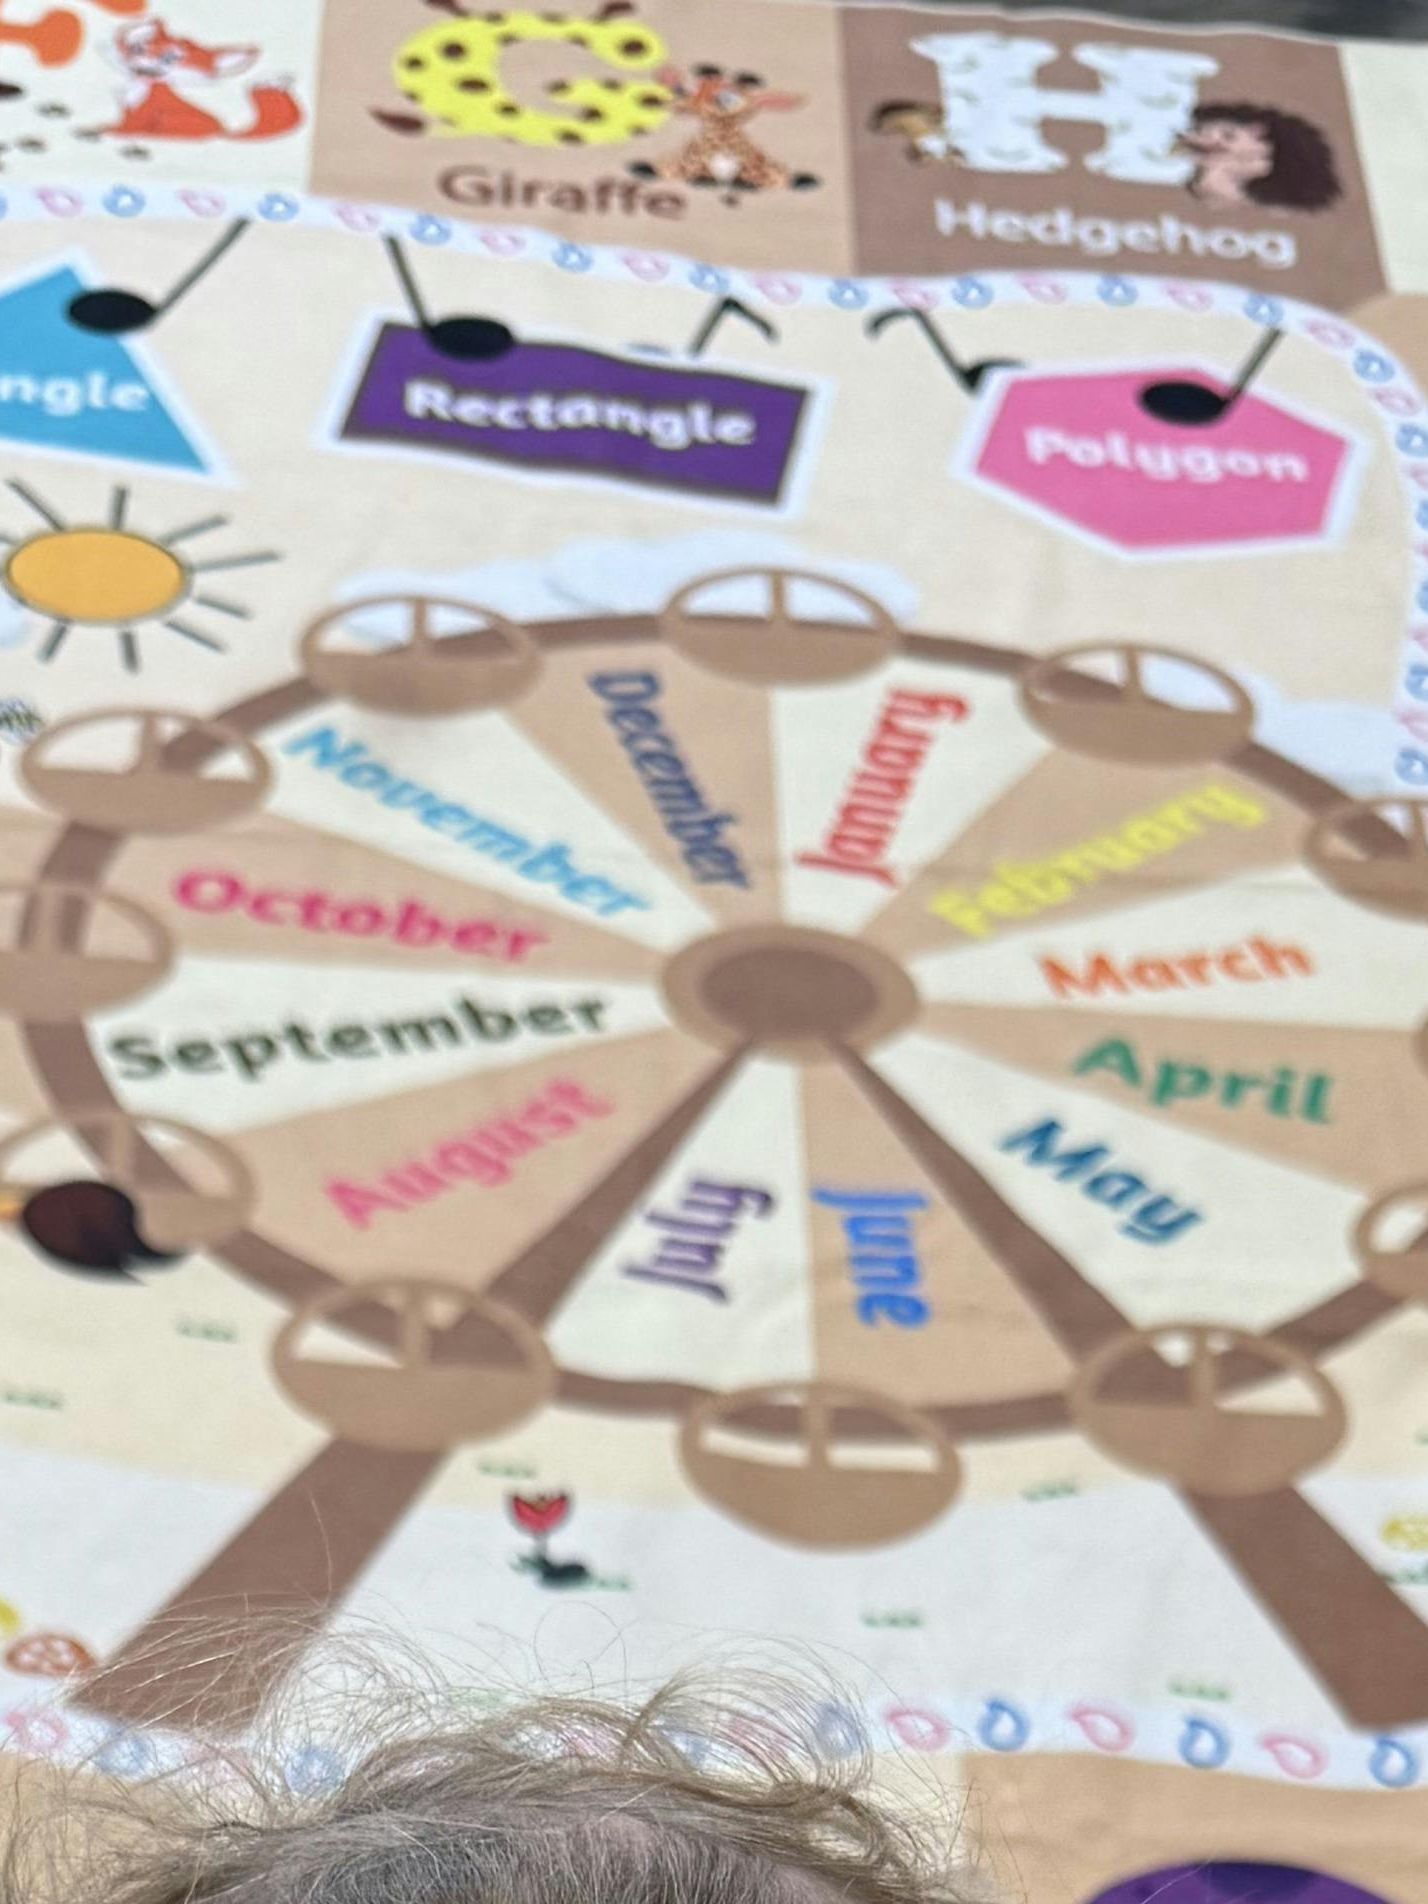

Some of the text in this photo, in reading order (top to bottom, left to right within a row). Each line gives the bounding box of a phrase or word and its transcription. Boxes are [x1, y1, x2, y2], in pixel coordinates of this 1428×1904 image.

[392, 10, 674, 147] G
[910, 31, 1220, 186] H
[439, 165, 689, 220] Giraffe
[934, 199, 1298, 269] Hedgehog
[404, 380, 758, 449] Rectangle
[1024, 427, 1310, 484] Polygon
[281, 726, 650, 918] November
[586, 671, 752, 890] December
[794, 687, 972, 890] January
[174, 871, 550, 962] October
[927, 783, 1267, 940] February
[1038, 936, 1314, 998] March
[108, 994, 611, 1083] September
[1072, 1036, 1334, 1125] April
[324, 1078, 614, 1230] August
[997, 1116, 1207, 1247] May
[619, 1176, 778, 1304] July
[811, 1185, 930, 1329] June
